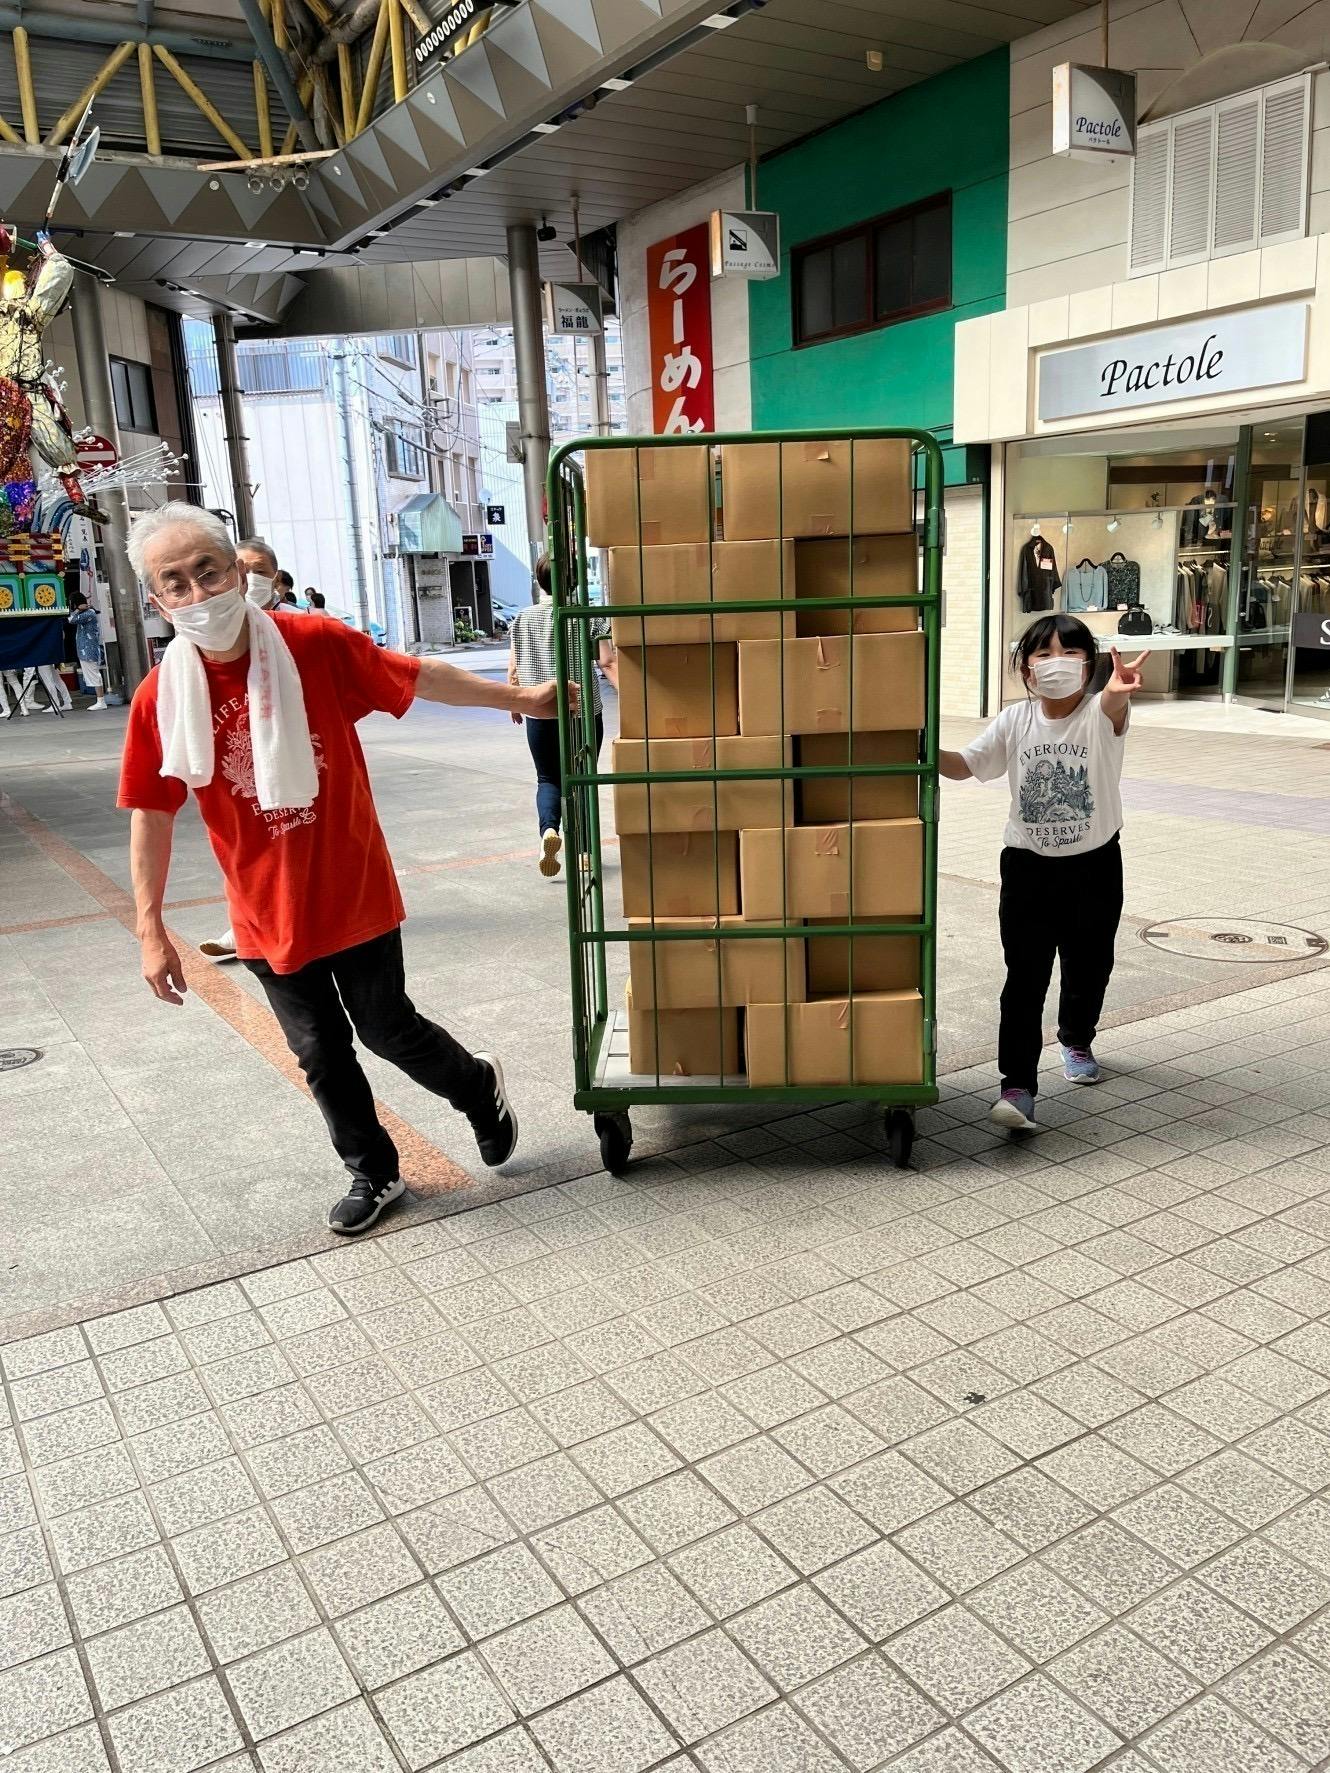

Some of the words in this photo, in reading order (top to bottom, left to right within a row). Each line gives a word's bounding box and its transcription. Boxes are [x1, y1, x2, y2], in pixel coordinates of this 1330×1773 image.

[1076, 116, 1121, 138] Pactole
[561, 315, 589, 328] 福龍
[659, 248, 705, 434] らーめん
[1100, 334, 1224, 397] Pactole
[1026, 821, 1091, 836] DESERVES
[1037, 836, 1050, 849] To
